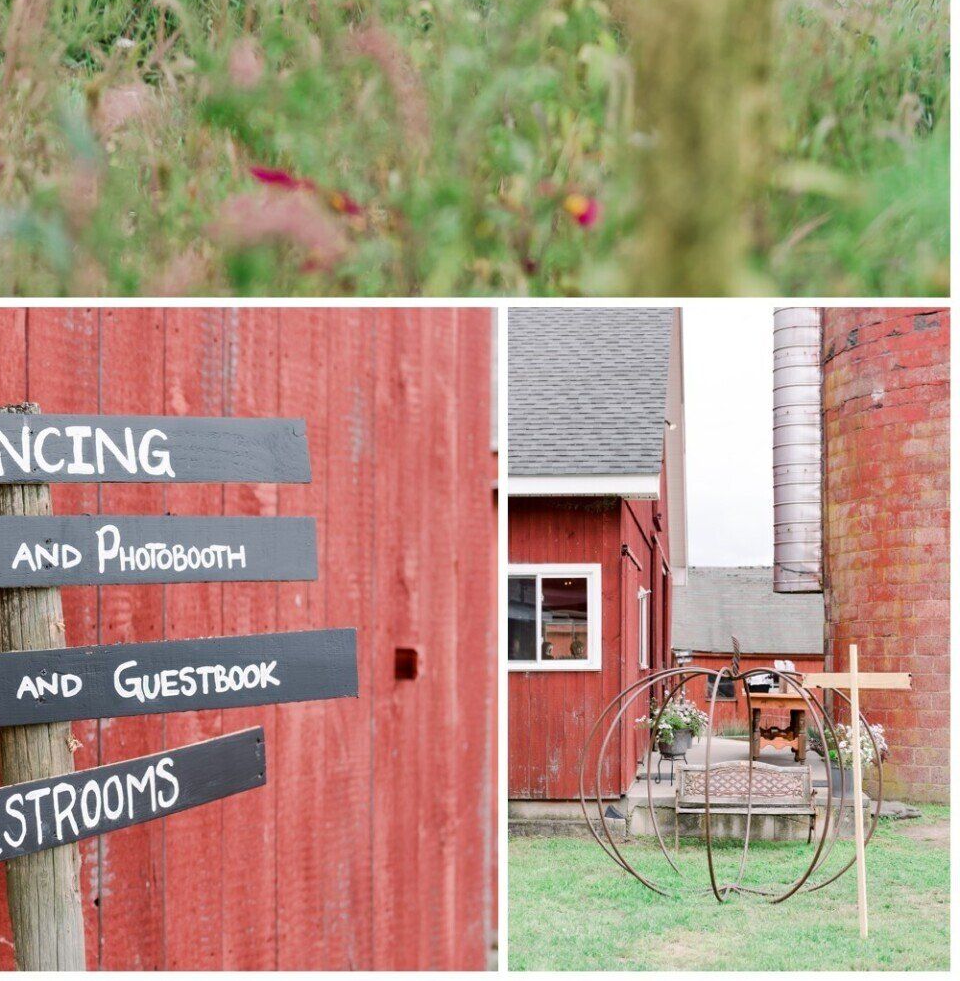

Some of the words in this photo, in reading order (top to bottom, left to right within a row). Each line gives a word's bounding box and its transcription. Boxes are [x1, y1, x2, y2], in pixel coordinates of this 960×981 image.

[12, 542, 82, 572] AND
[17, 672, 83, 700] AND
[114, 660, 281, 703] GUESTBOOK
